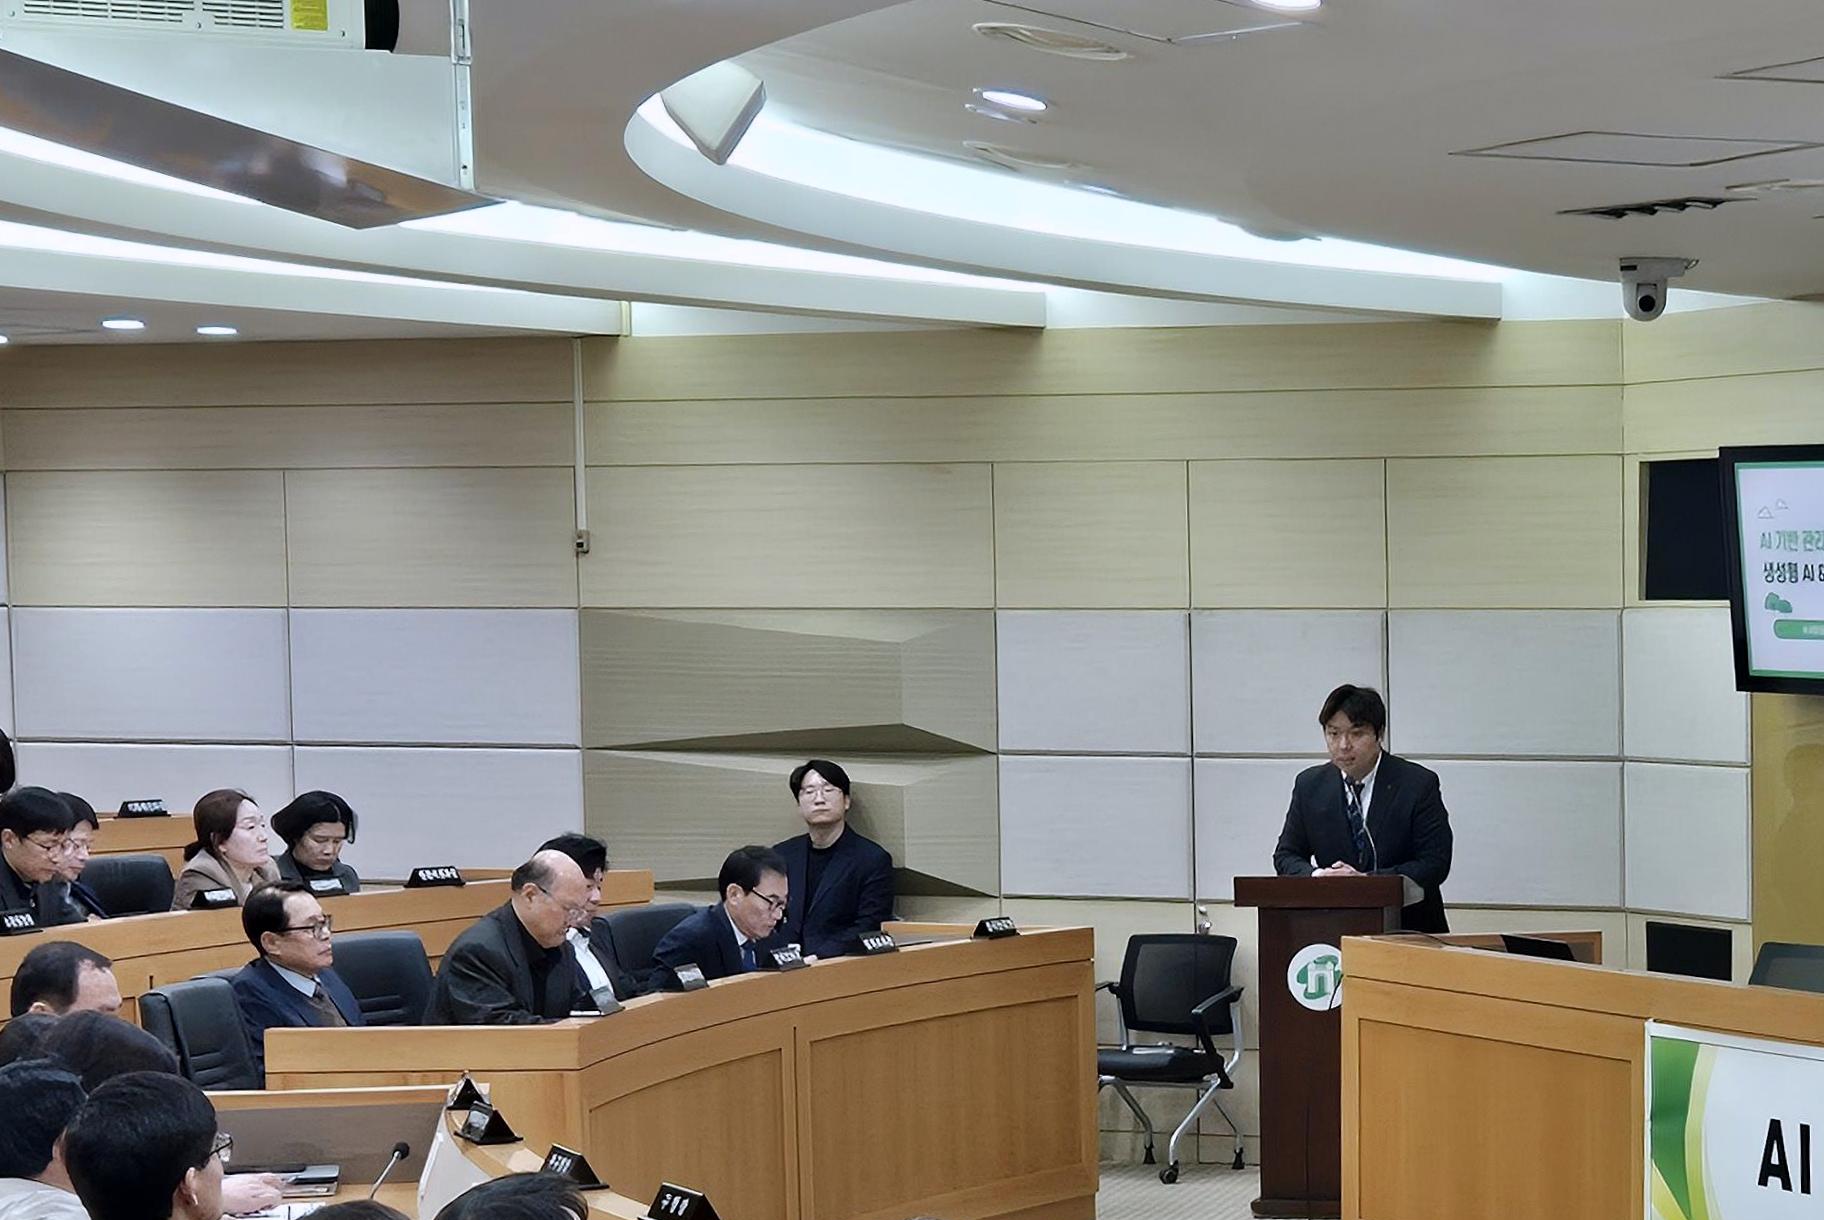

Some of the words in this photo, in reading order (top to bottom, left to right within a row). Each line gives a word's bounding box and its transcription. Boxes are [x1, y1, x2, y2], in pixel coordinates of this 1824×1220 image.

[1760, 531, 1772, 550] AI
[1775, 530, 1799, 553] 기반
[1763, 561, 1799, 584] 생성형
[1802, 563, 1814, 582] AI
[1756, 1117, 1812, 1196] AI
